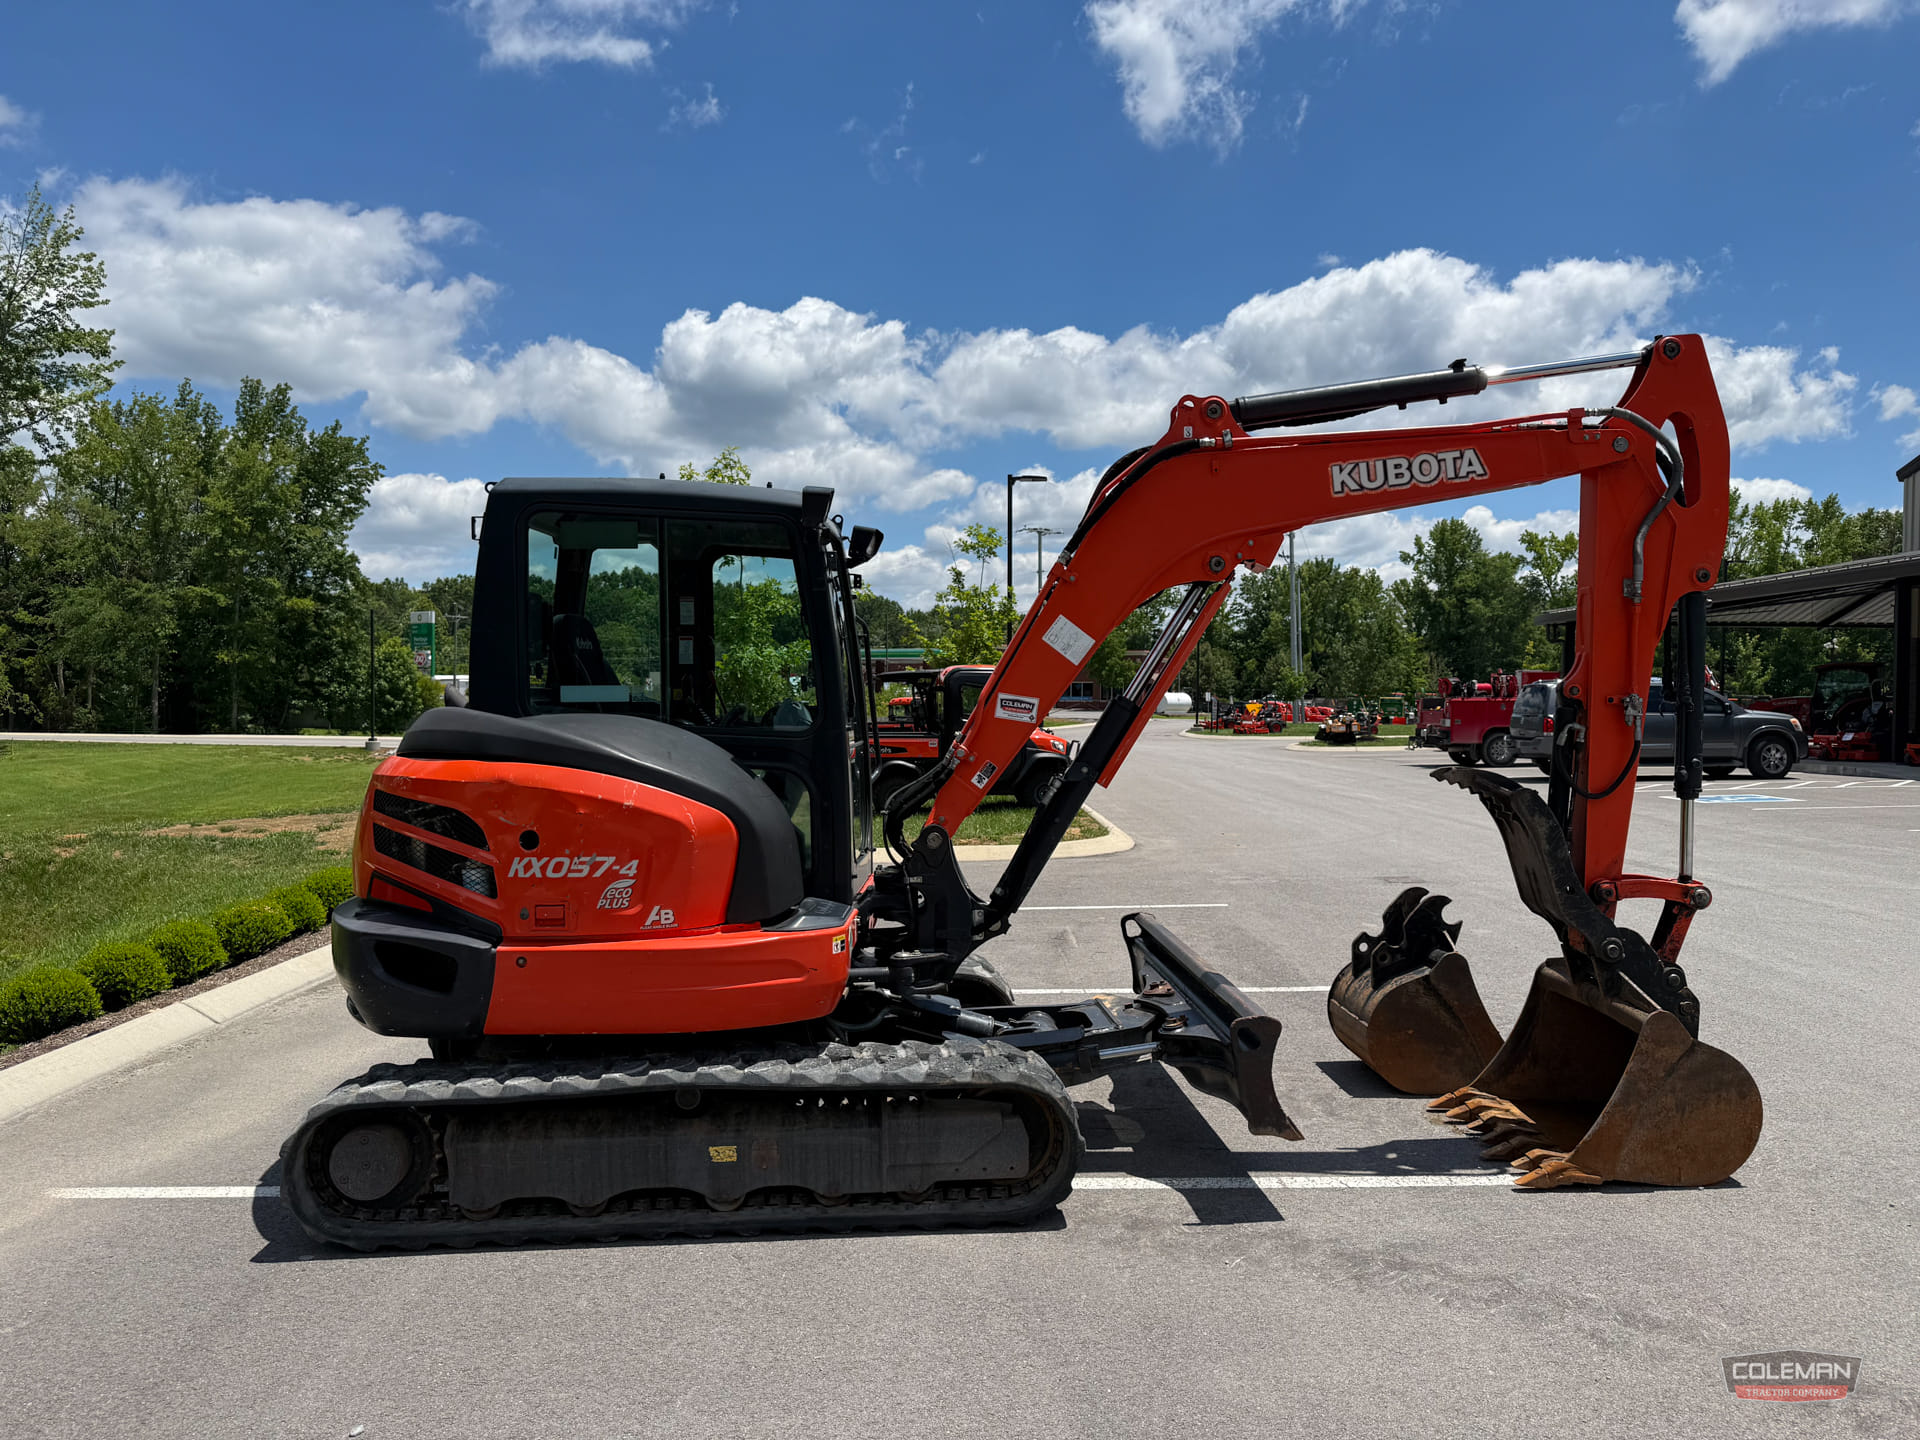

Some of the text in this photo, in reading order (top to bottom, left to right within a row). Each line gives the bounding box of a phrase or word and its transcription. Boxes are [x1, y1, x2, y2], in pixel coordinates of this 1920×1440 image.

[1331, 448, 1487, 495] KUBOTA
[1002, 700, 1033, 709] COLEMAN
[508, 856, 639, 878] KX057-4
[596, 898, 631, 909] PLUS
